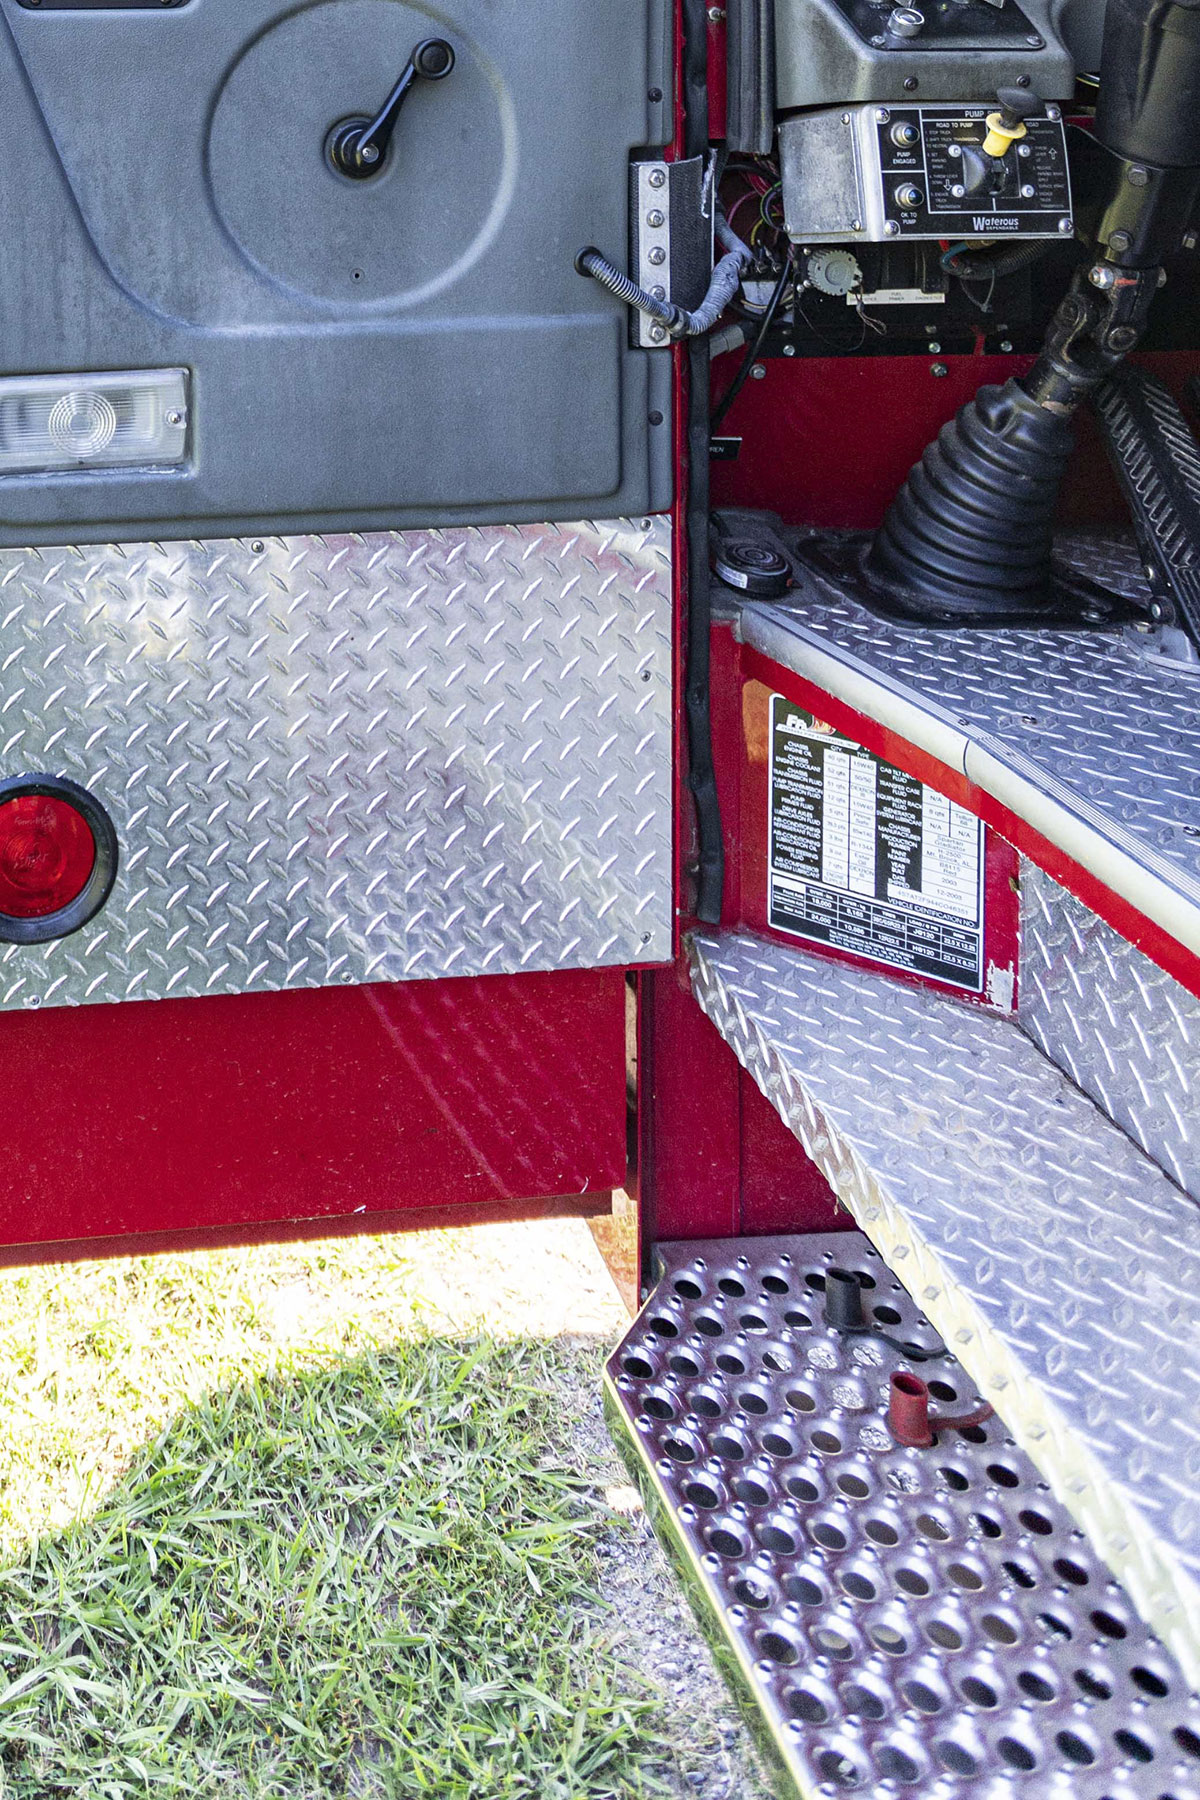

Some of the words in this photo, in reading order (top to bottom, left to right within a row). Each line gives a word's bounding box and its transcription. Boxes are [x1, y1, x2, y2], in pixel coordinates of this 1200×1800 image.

[965, 110, 984, 118] PUMP
[973, 216, 1019, 231] Waterous
[812, 897, 832, 908] 18,000
[887, 897, 913, 910] VEHICLE
[914, 904, 962, 925] IDENTIFICATION
[811, 914, 831, 924] 24,000
